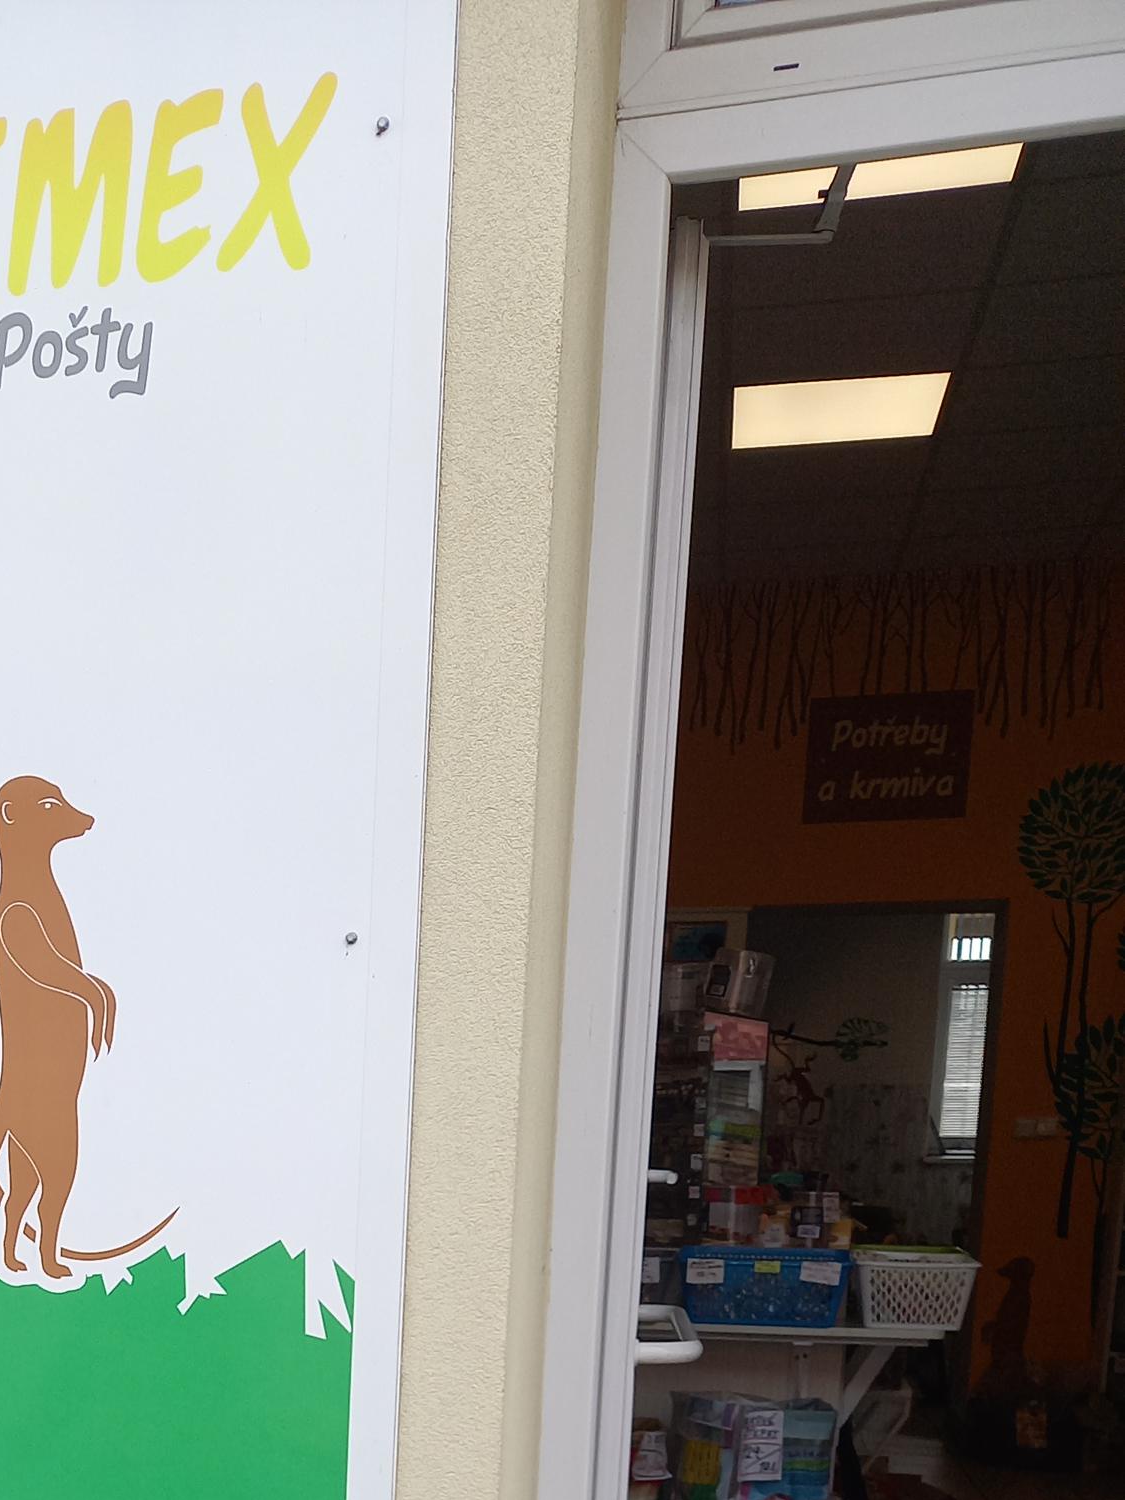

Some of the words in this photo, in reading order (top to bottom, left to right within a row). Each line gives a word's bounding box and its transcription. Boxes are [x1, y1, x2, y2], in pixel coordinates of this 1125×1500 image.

[830, 715, 948, 755] Potřeby
[817, 780, 836, 802] a
[848, 767, 955, 800] krmiva
